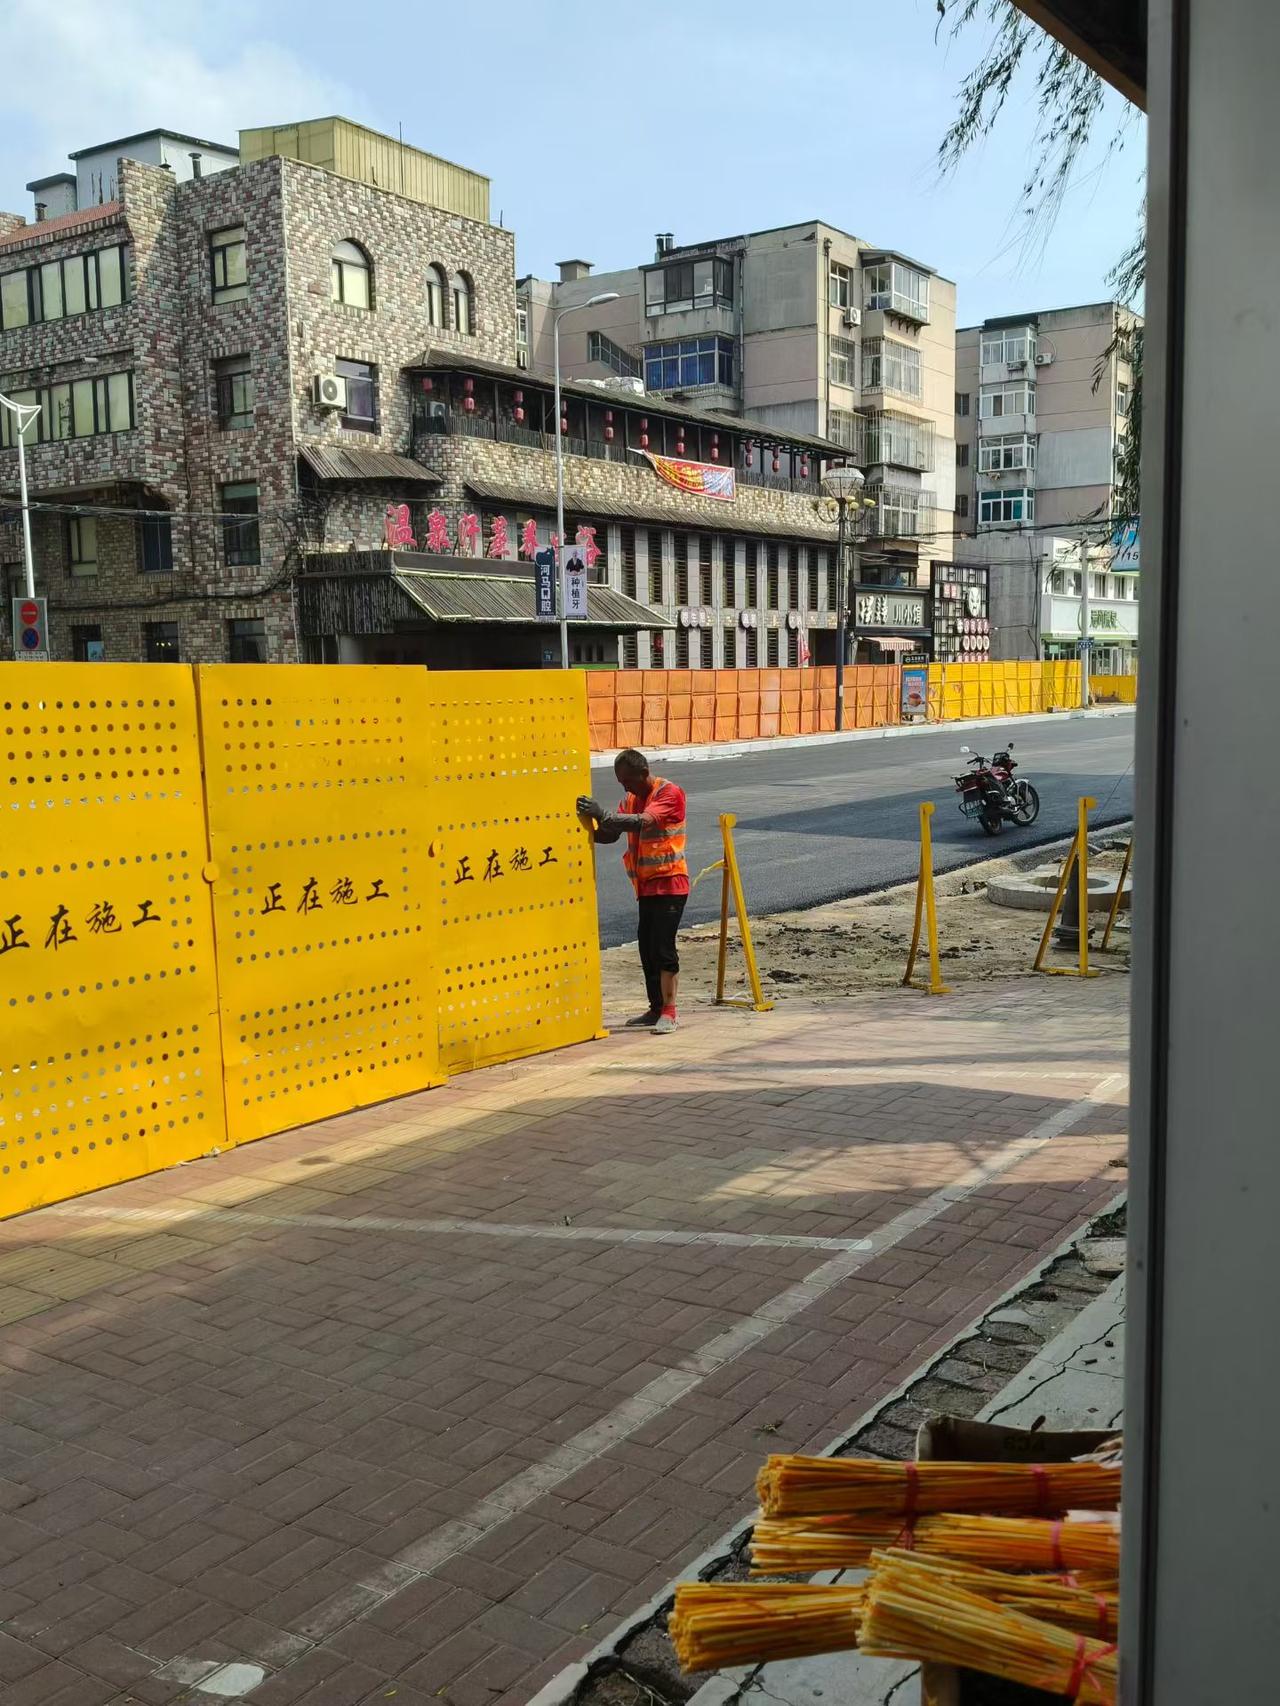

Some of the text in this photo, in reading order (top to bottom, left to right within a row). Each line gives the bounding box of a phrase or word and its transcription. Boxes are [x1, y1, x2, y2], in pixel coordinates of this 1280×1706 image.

[540, 564, 552, 612] 河马口腔
[571, 577, 581, 610] 种植牙
[453, 846, 559, 885] 正在施工
[260, 876, 390, 916] 正在施工
[0, 899, 162, 955] 正在施工
